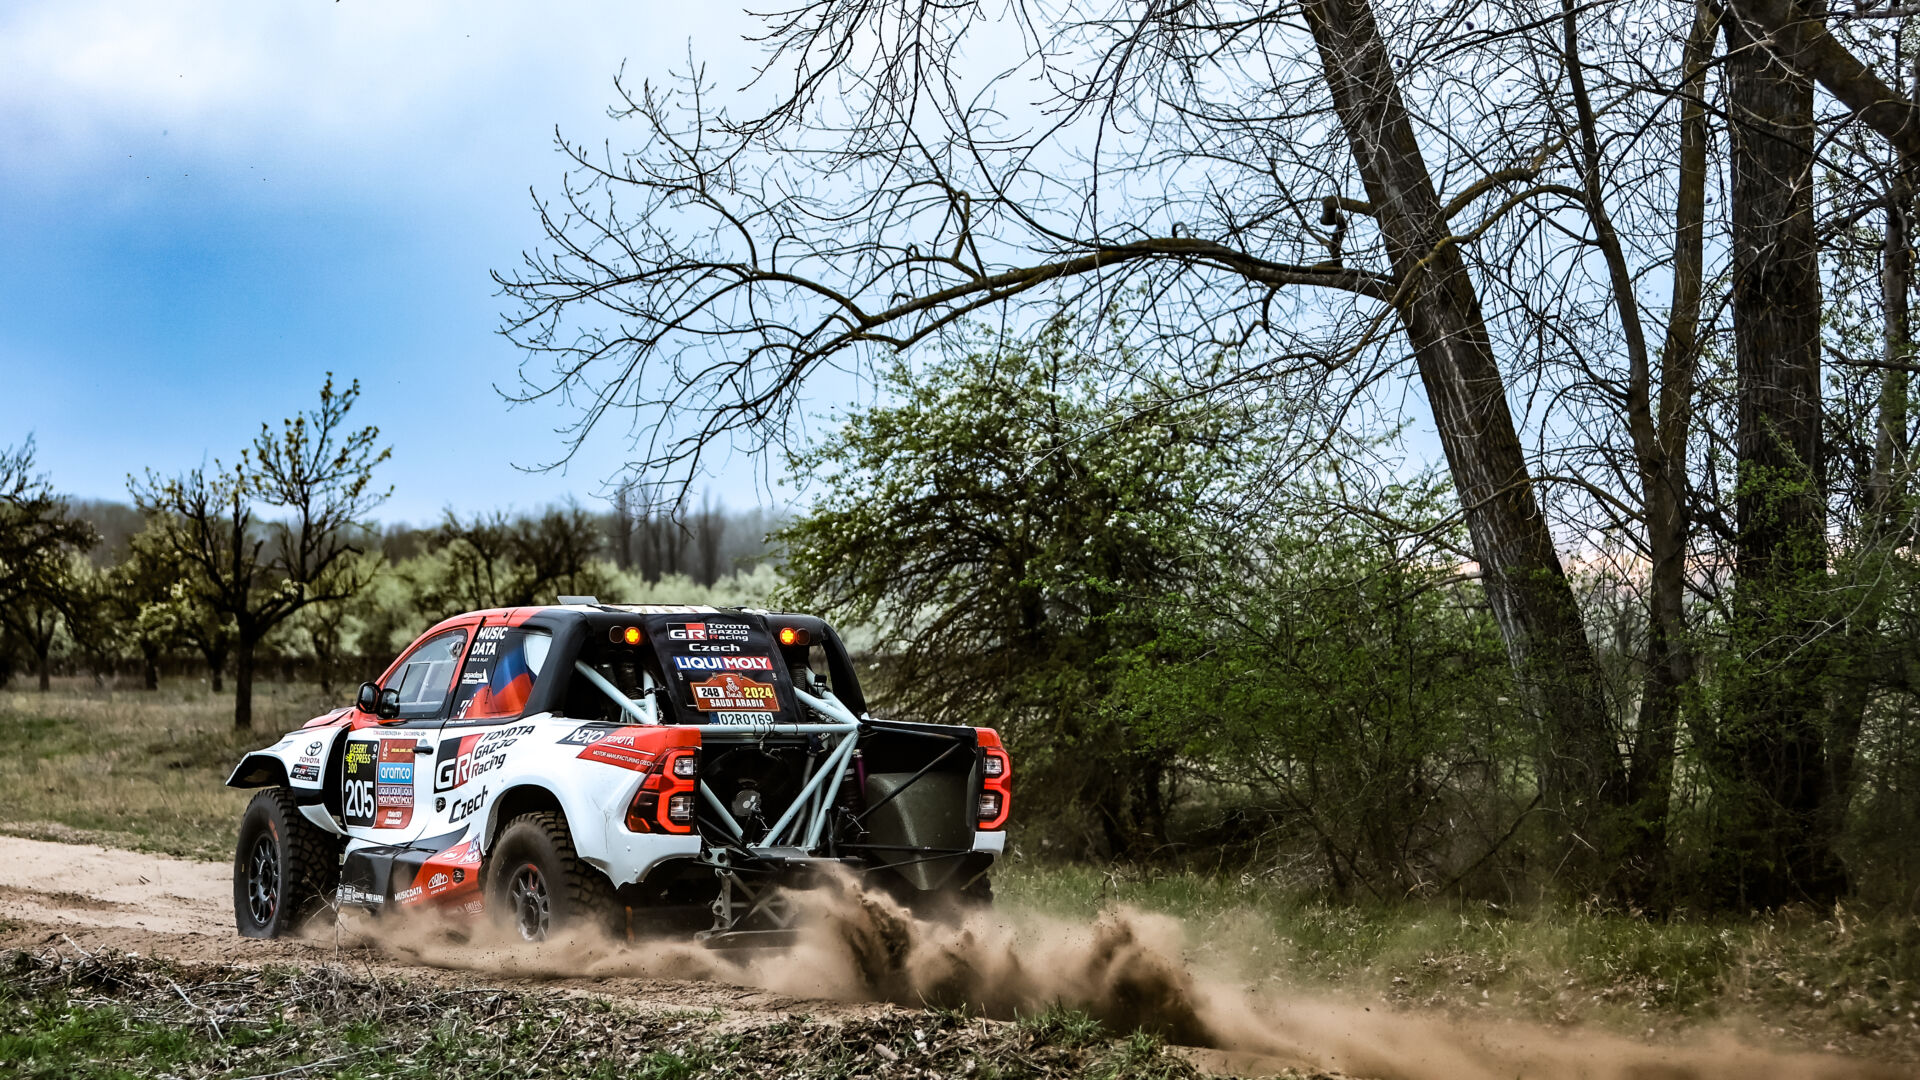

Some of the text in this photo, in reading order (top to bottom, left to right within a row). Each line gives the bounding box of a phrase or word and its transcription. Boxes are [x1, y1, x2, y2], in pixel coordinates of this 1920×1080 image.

[477, 627, 508, 639] MUSIC
[669, 629, 705, 639] GR
[471, 642, 496, 655] DATA
[689, 644, 740, 652] Czech
[676, 657, 768, 670] LIQUI MOLY
[701, 687, 720, 697] 248
[744, 687, 774, 698] 2024
[710, 699, 765, 708] SAUDI ARABIA
[482, 725, 536, 742] TOYOTA
[566, 728, 634, 746] NEXO TOYOTA
[350, 744, 368, 754] DESERT
[606, 752, 640, 764] MANUFACTURING
[348, 762, 358, 774] 300
[435, 752, 472, 790] GR
[471, 754, 506, 778] Racing
[380, 766, 410, 780] aramco
[345, 779, 374, 818] 205
[448, 784, 488, 824] Czech
